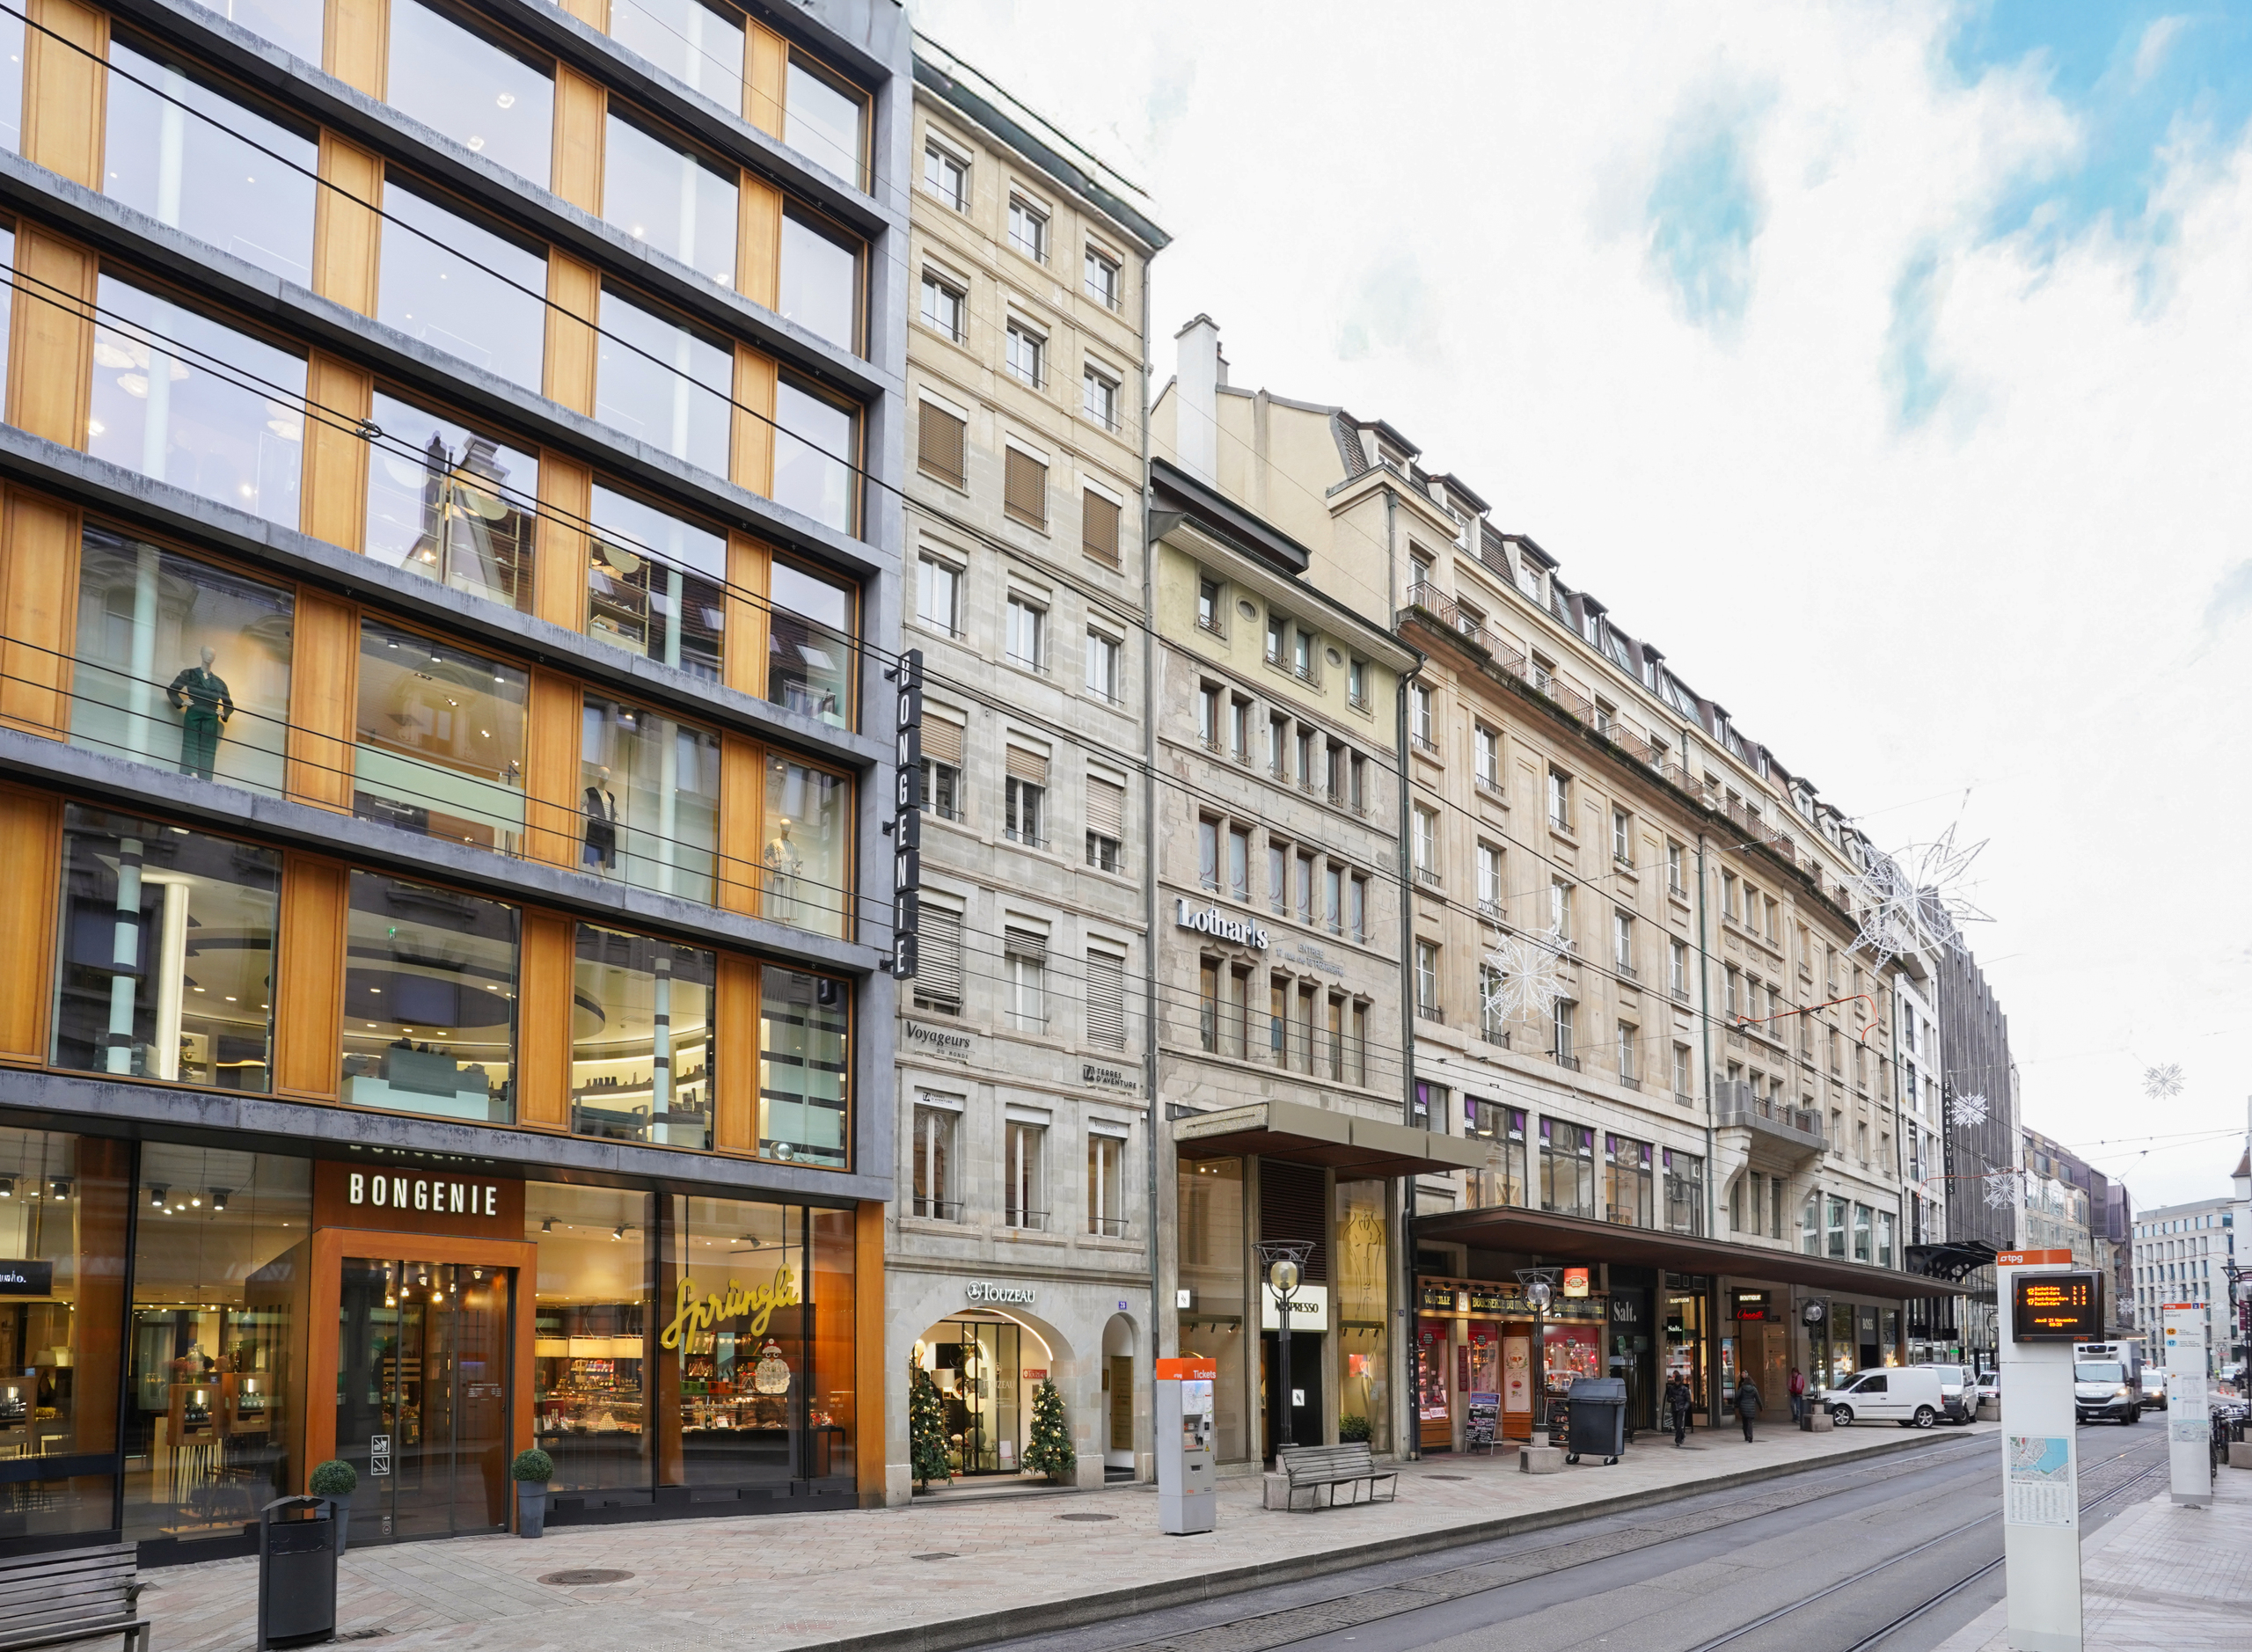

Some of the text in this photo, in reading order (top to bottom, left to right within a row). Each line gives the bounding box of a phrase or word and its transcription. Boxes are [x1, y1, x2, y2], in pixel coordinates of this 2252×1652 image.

[896, 656, 911, 974] BONGENIE
[906, 1020, 971, 1049] Voyageurs
[1096, 1075, 1137, 1089] D'AVENTURE
[1097, 1068, 1122, 1078] TERRES
[1945, 1141, 1954, 1194] SUITES
[350, 1173, 497, 1216] BONGENIE
[2008, 1254, 2023, 1263] tpg
[981, 1282, 1035, 1303] TOUZEAU
[661, 1262, 799, 1355] Sprüngli
[1472, 1297, 1505, 1309] BOUCHERIE
[1506, 1300, 1514, 1310] DU
[1613, 1301, 1637, 1322] Salt.
[1862, 1318, 1874, 1330] BOSS
[1193, 1370, 1217, 1379] Tickets
